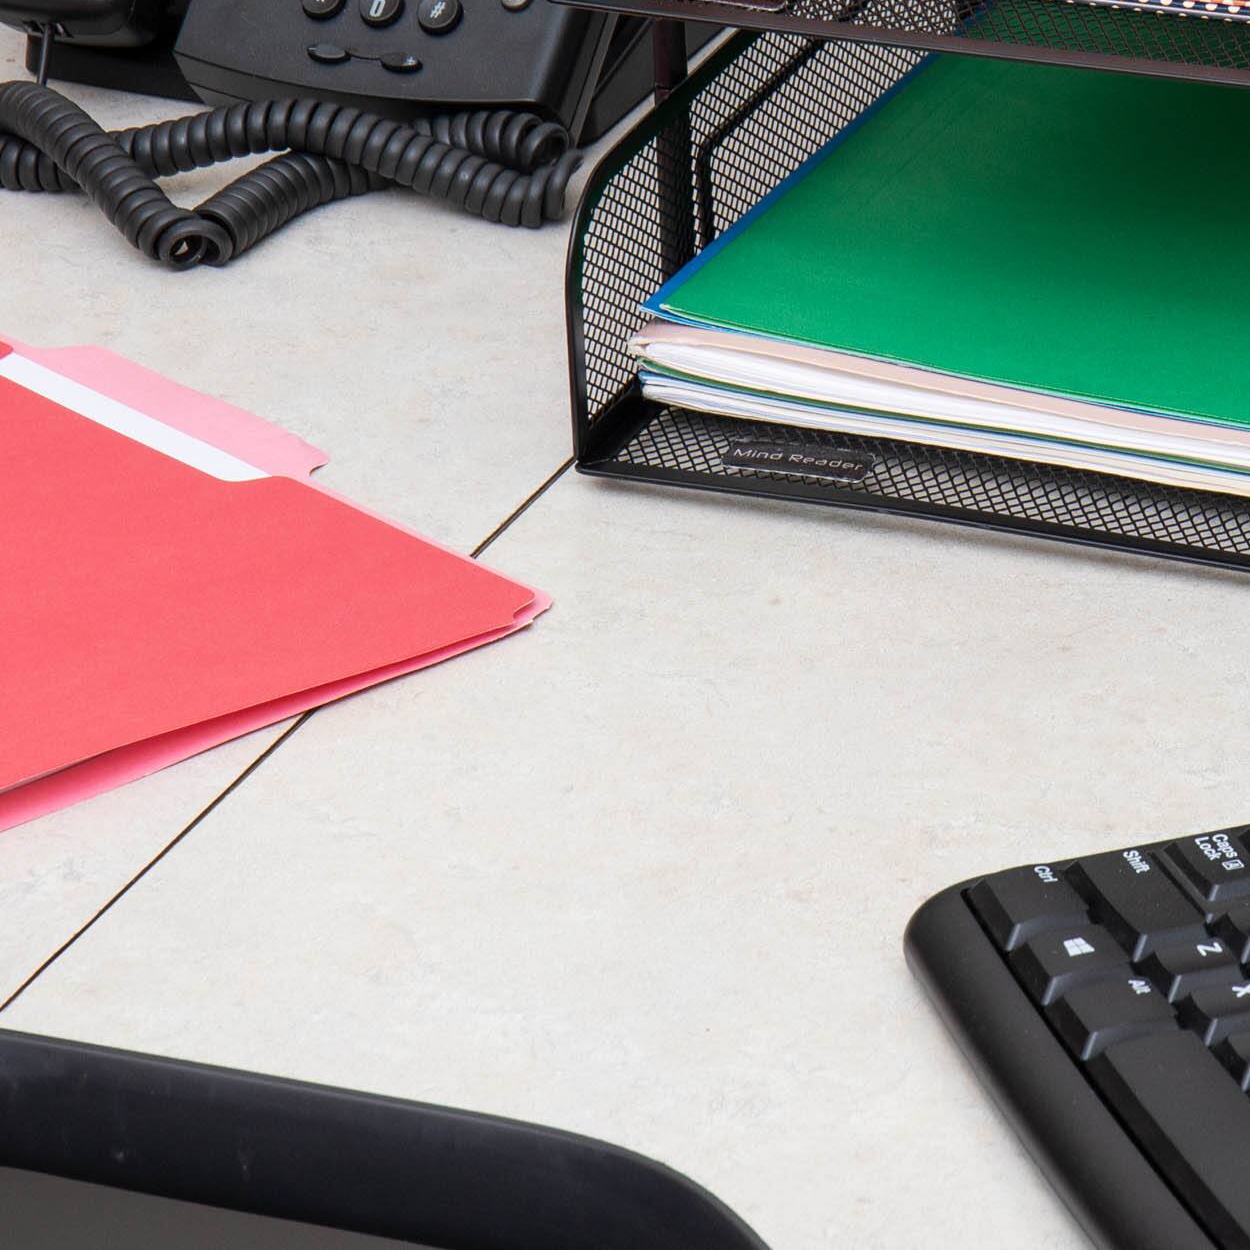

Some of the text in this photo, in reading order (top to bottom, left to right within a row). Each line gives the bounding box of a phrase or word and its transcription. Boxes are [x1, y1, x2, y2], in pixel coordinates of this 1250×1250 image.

[430, 0, 446, 19] #
[733, 447, 864, 472] Mind Reader
[1195, 836, 1222, 861] Lock
[1212, 833, 1239, 858] Caps
[1122, 849, 1151, 874] Shift
[1033, 865, 1059, 883] Ctrl
[1196, 941, 1223, 957] Z
[1127, 979, 1152, 995] Alt
